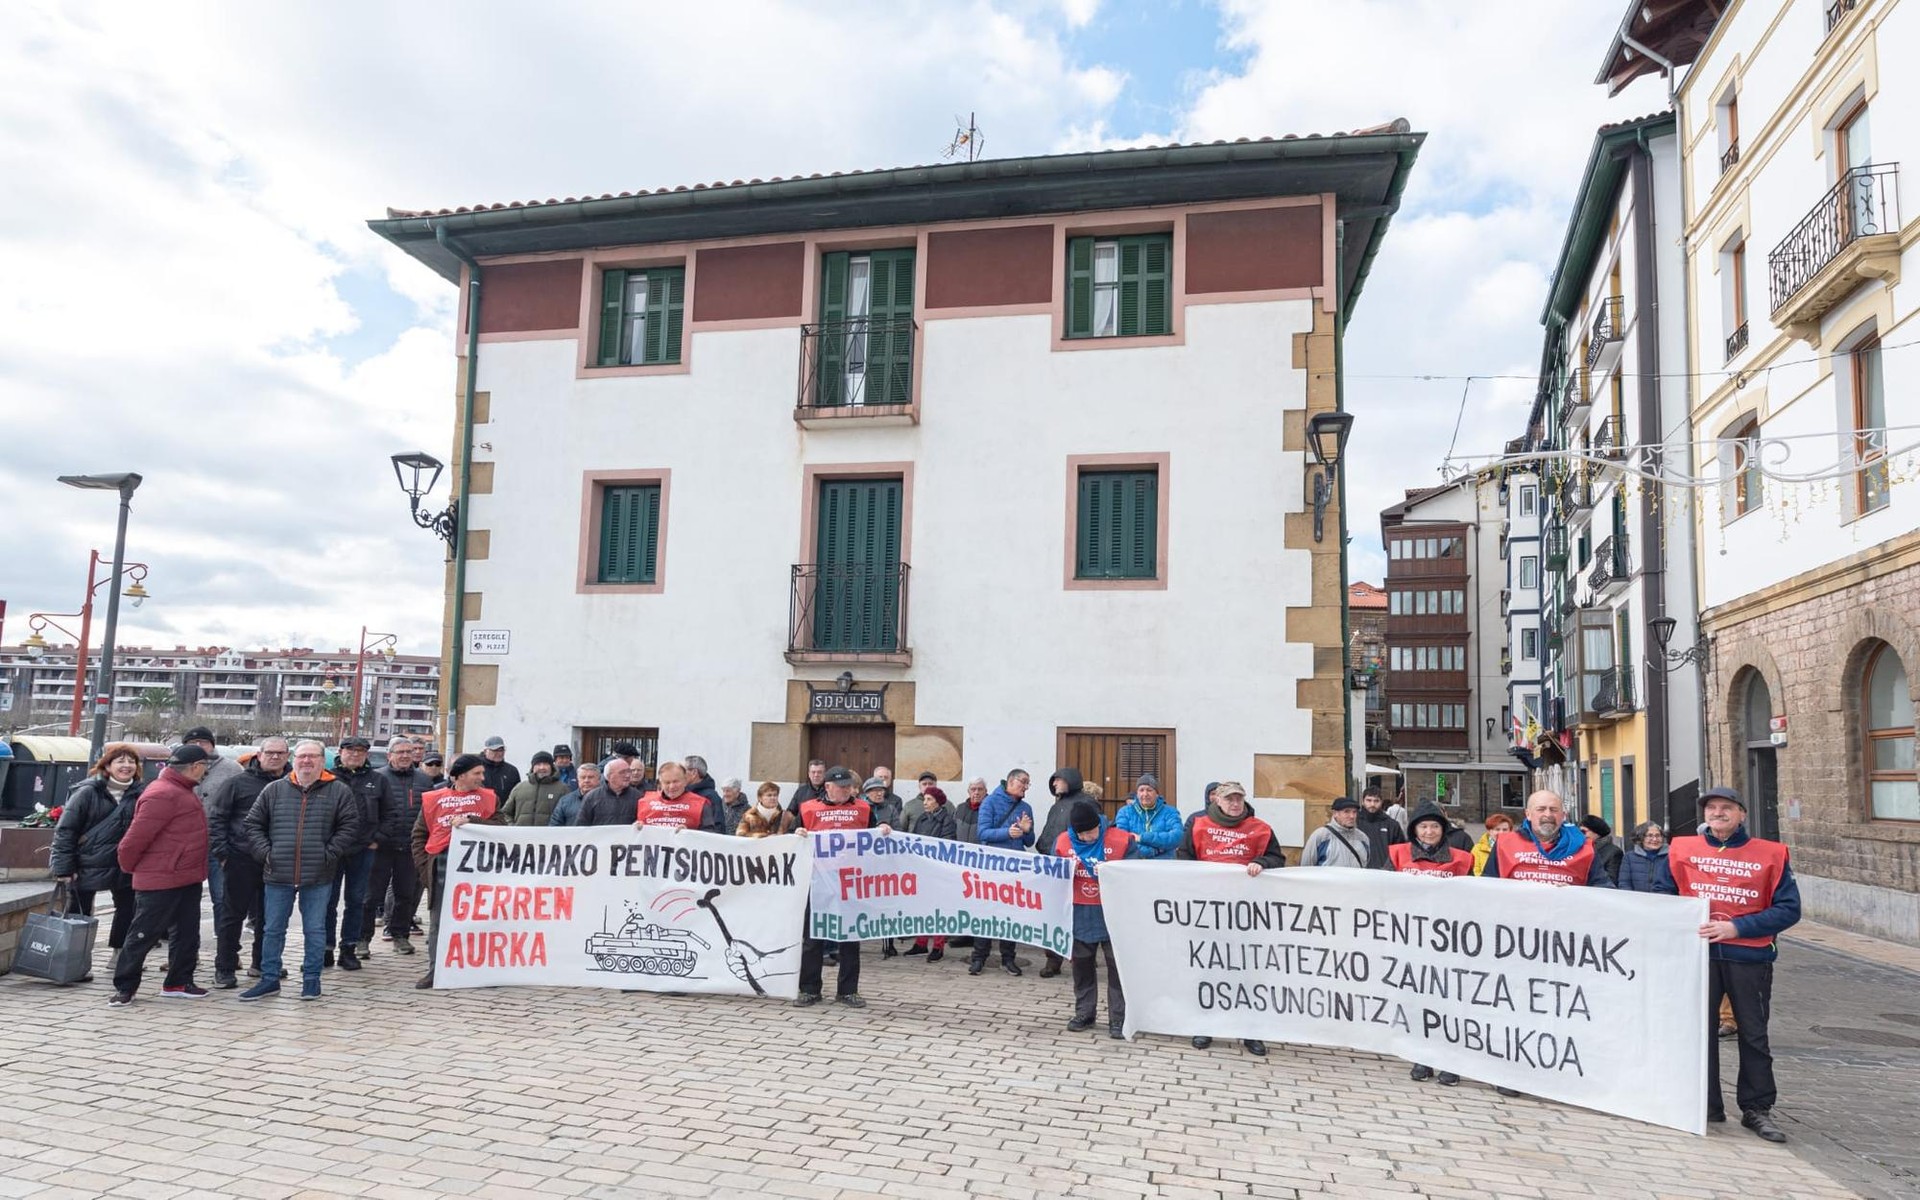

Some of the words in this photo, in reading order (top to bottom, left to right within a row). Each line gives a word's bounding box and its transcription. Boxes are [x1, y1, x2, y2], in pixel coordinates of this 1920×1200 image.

[456, 840, 598, 877] ZUMAIAKO
[609, 844, 796, 886] PENTSIODUNAK
[1513, 871, 1574, 883] GUTXIENEKO
[1690, 856, 1762, 871] GUTXIENEKO
[1697, 864, 1752, 878] PENTSIOA
[451, 882, 574, 921] GERREN
[838, 866, 917, 901] Firma
[961, 870, 1042, 911] Sinatu
[1690, 882, 1759, 898] GUTXIENEKO
[1697, 892, 1747, 905] SOLDATA
[445, 931, 548, 969] AURKA
[1153, 899, 1341, 936] GUZTIONTZAT
[1353, 908, 1483, 957] PENTSIO
[1495, 924, 1635, 981] DUINAK,
[1189, 940, 1370, 982] KALITATEZKO
[1381, 955, 1515, 1012] ZAINTZA
[1528, 978, 1591, 1022] ETA
[1199, 981, 1411, 1034] OSASUNGINTZA
[1423, 1008, 1583, 1077] PUBLIKOA
